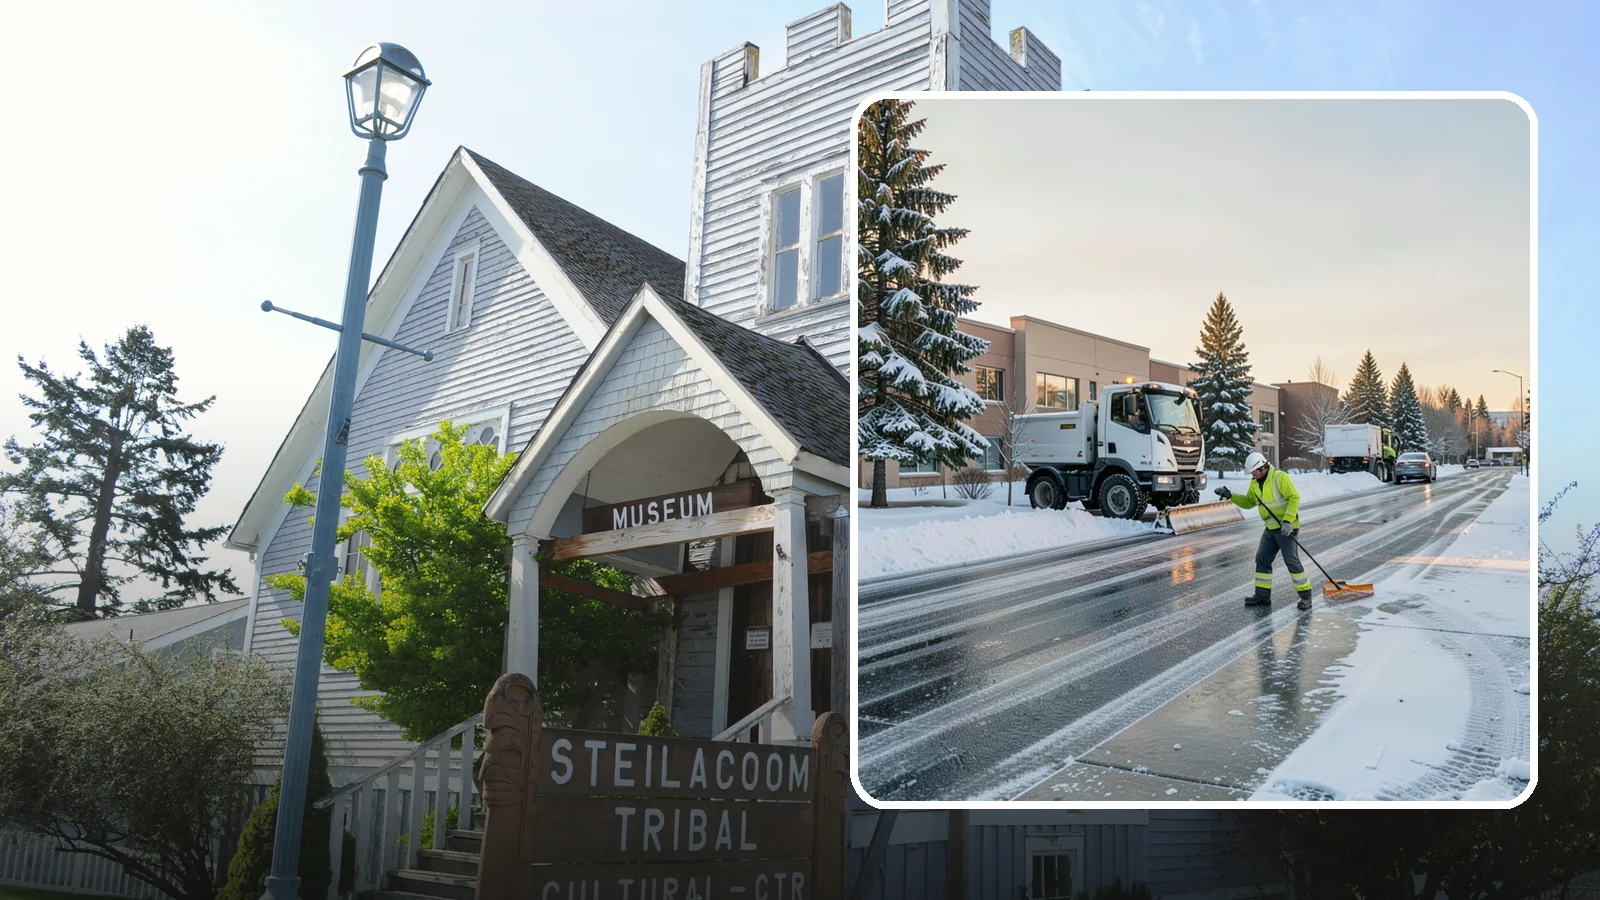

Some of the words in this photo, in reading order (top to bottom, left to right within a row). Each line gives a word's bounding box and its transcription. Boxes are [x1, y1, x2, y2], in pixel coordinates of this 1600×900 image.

[612, 491, 714, 531] MUSEUM
[550, 738, 809, 793] STEILACOOM
[614, 806, 758, 852] TRIBAL
